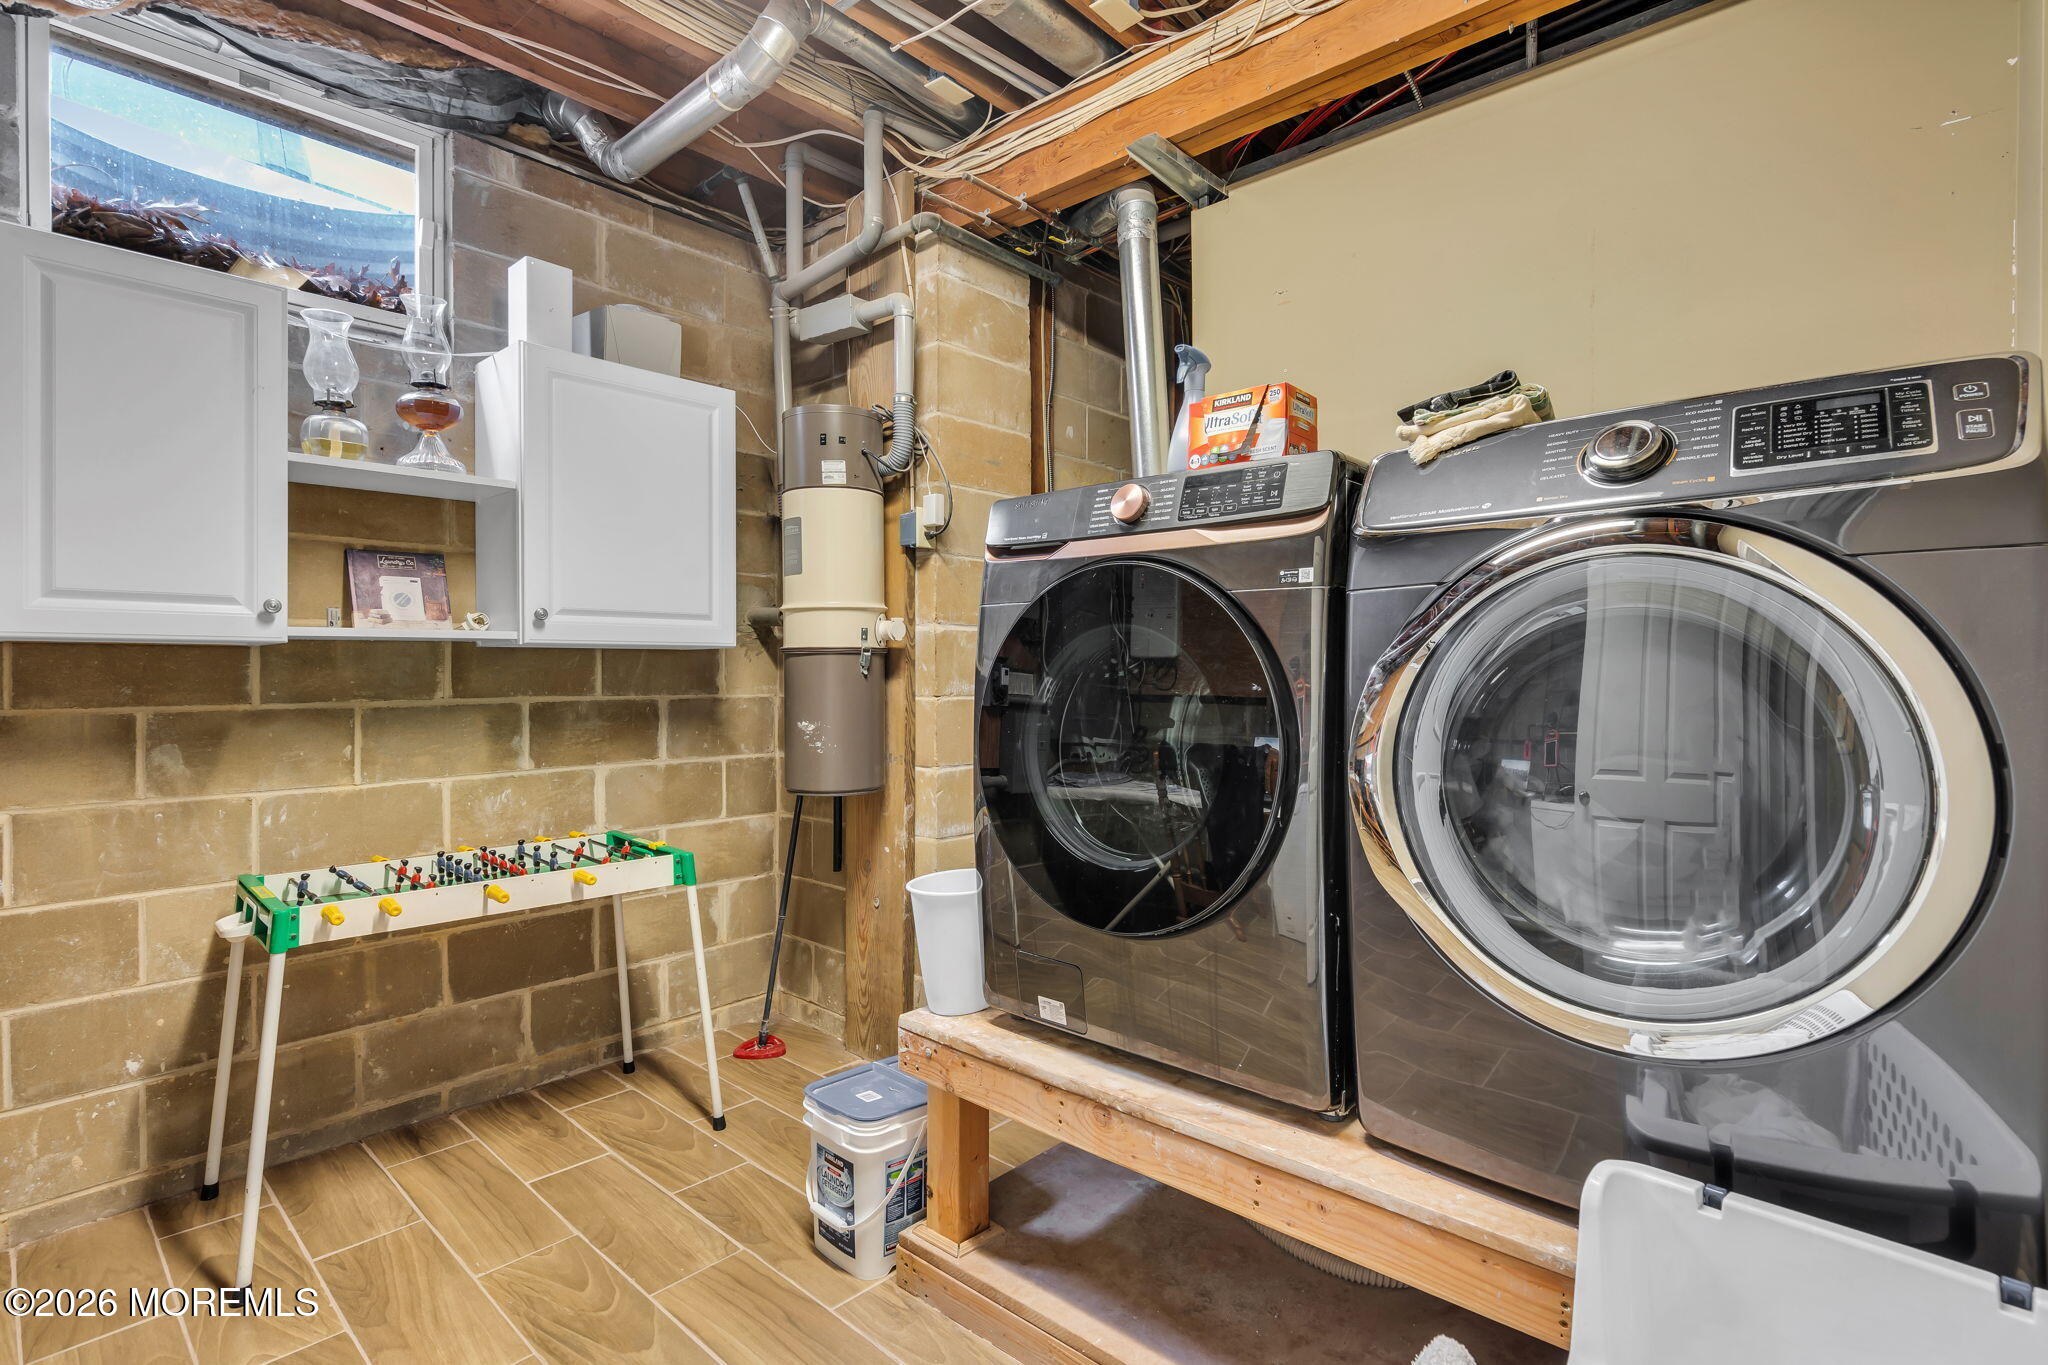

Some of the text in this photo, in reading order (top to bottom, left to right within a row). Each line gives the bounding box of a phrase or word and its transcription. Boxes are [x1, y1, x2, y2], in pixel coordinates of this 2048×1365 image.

[1214, 393, 1252, 407] KIRKLAND
[1269, 388, 1281, 397] 250
[821, 1170, 850, 1192] LAUNDRY
[821, 1178, 848, 1199] DETERGENT
